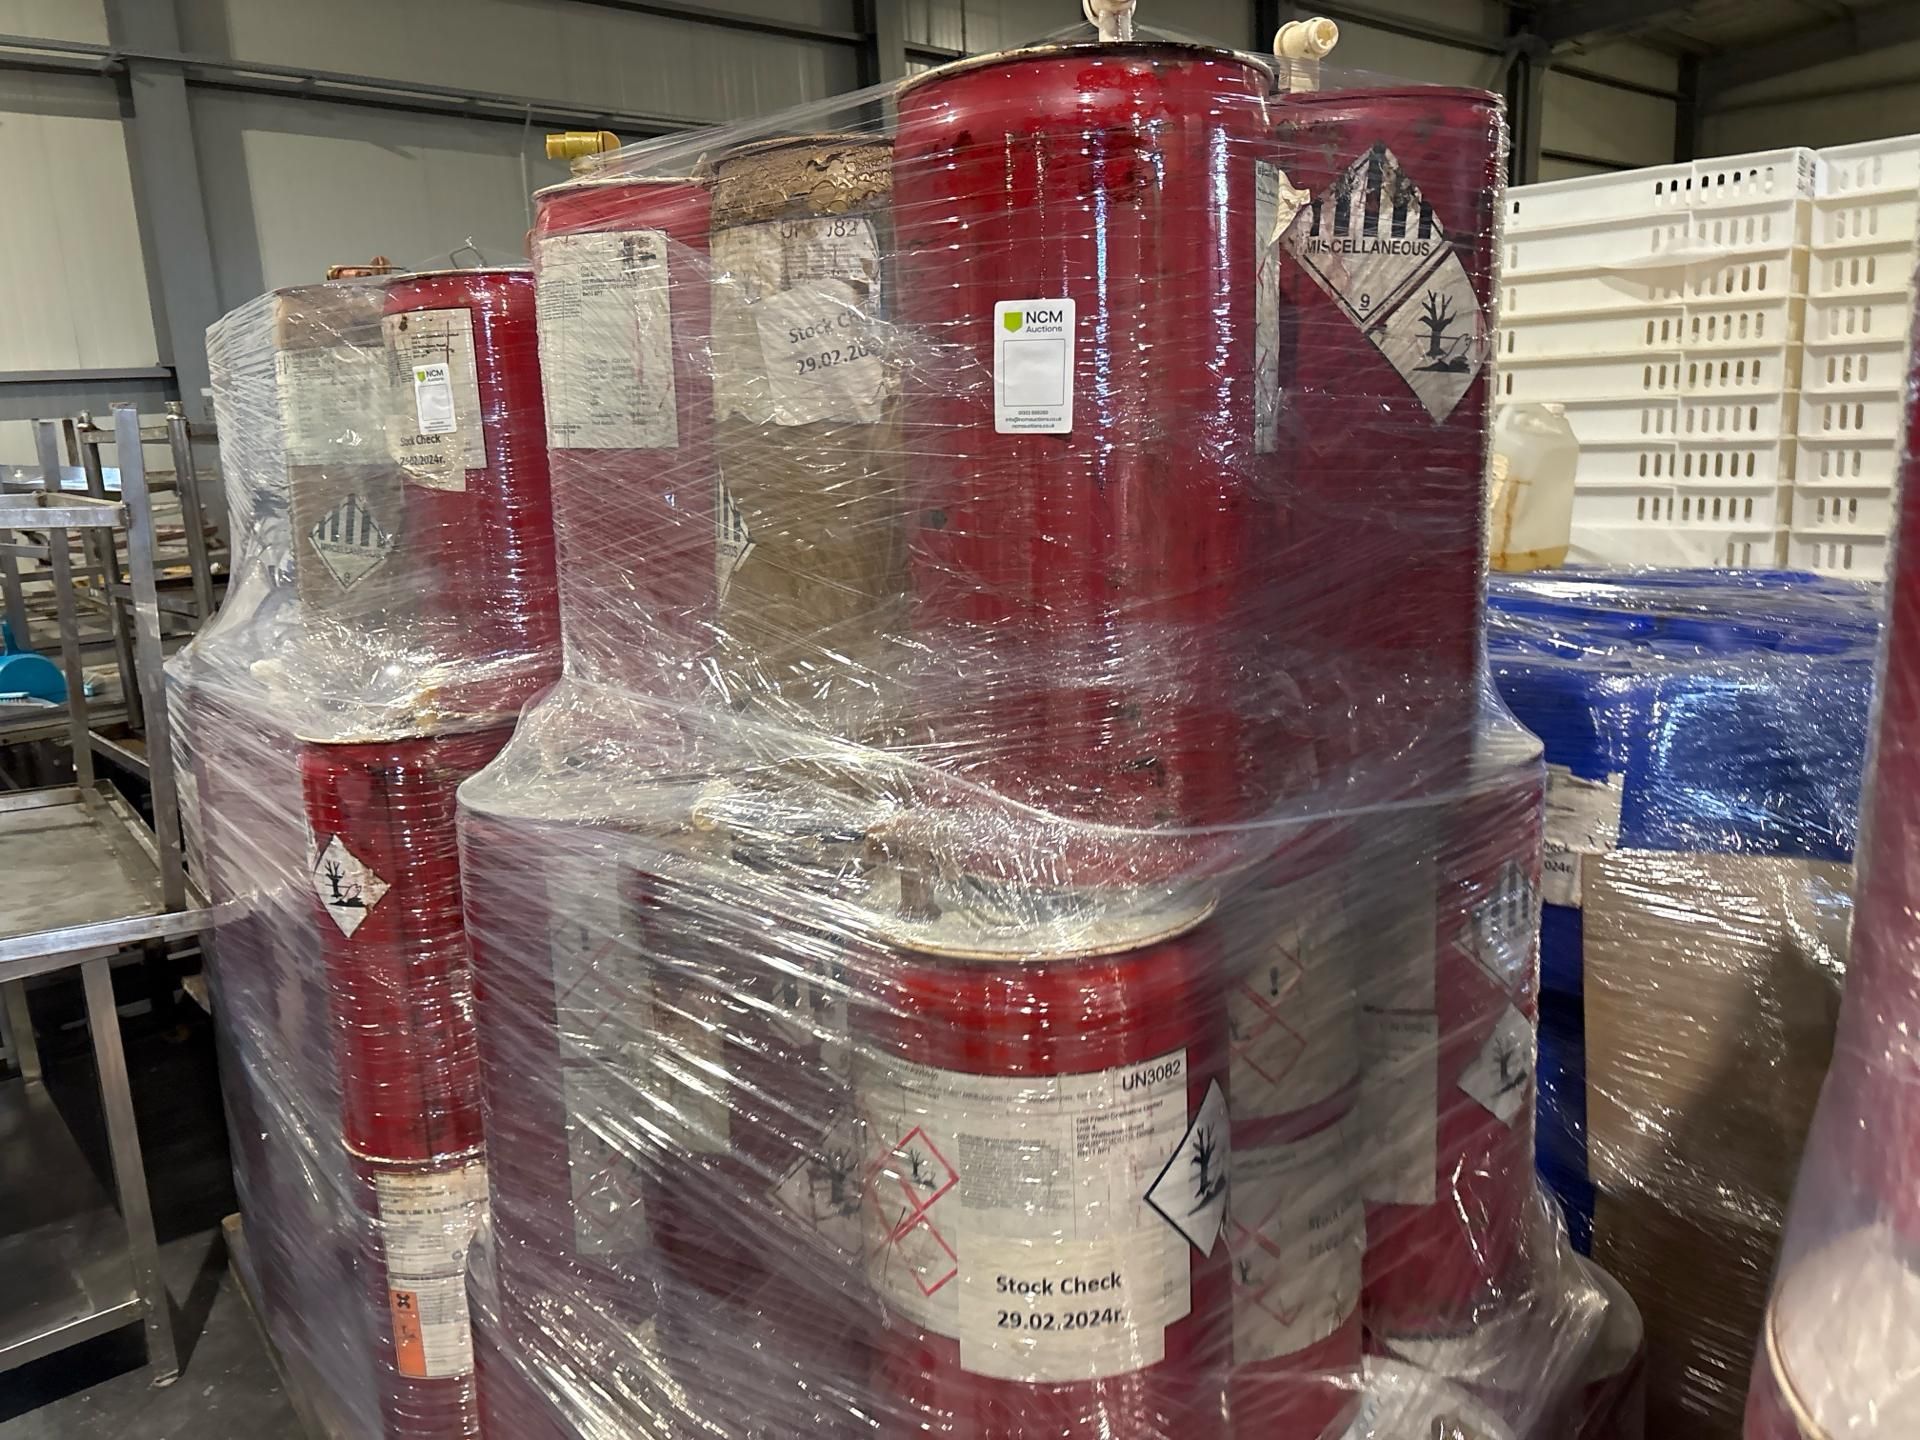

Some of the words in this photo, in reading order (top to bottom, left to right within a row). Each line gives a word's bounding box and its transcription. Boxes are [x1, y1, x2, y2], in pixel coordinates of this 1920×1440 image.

[1305, 238, 1431, 257] MISCELLANEOUS
[1360, 293, 1371, 309] 9
[1026, 310, 1064, 324] NCM
[789, 317, 834, 344] Stock
[1026, 325, 1063, 333] Auctions
[796, 344, 870, 376] 29.02.20
[426, 369, 444, 378] NCM
[416, 433, 441, 445] Check
[1544, 860, 1575, 875] 024r.
[1121, 1059, 1181, 1092] UN3082
[996, 1275, 1053, 1296] Stock
[1060, 1271, 1123, 1295] Check
[997, 1307, 1126, 1331] 29.02.2024r.
